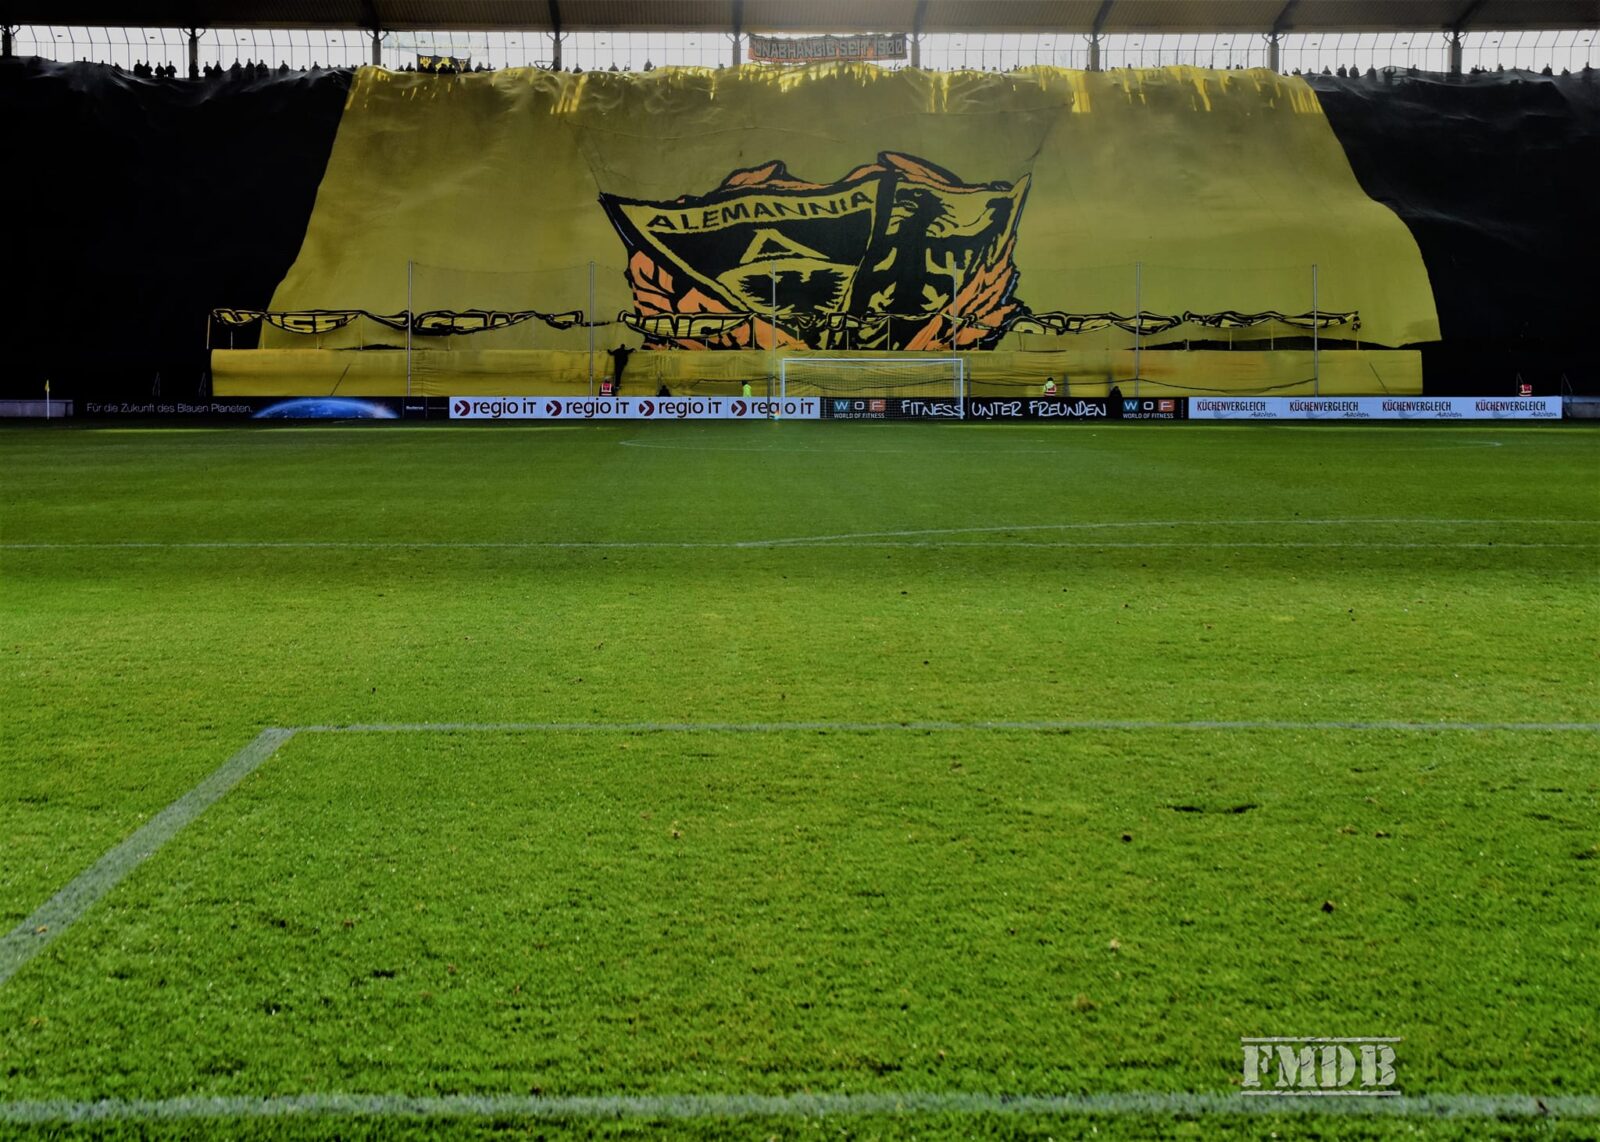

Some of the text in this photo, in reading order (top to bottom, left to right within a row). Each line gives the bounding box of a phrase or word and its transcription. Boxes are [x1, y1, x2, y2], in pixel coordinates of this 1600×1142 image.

[646, 191, 874, 231] ALEMANNIA
[87, 402, 102, 412] Für
[104, 403, 118, 412] die
[120, 402, 155, 413] Zukunft
[157, 402, 175, 413] des
[177, 402, 209, 413] Blauen
[473, 397, 519, 418] regio
[566, 397, 611, 418] regio
[658, 397, 704, 418] regio
[751, 401, 796, 418] rego
[900, 400, 1107, 417] FITNESS UNTER FREUNDEN
[1196, 400, 1266, 412] KÜCHENVERGLEICH
[1289, 400, 1359, 412] KÜCHENVERGLEICH
[1382, 400, 1452, 412] KÜCHENVERGLEICH
[1475, 400, 1546, 412] KÜCHENVERGLEICH
